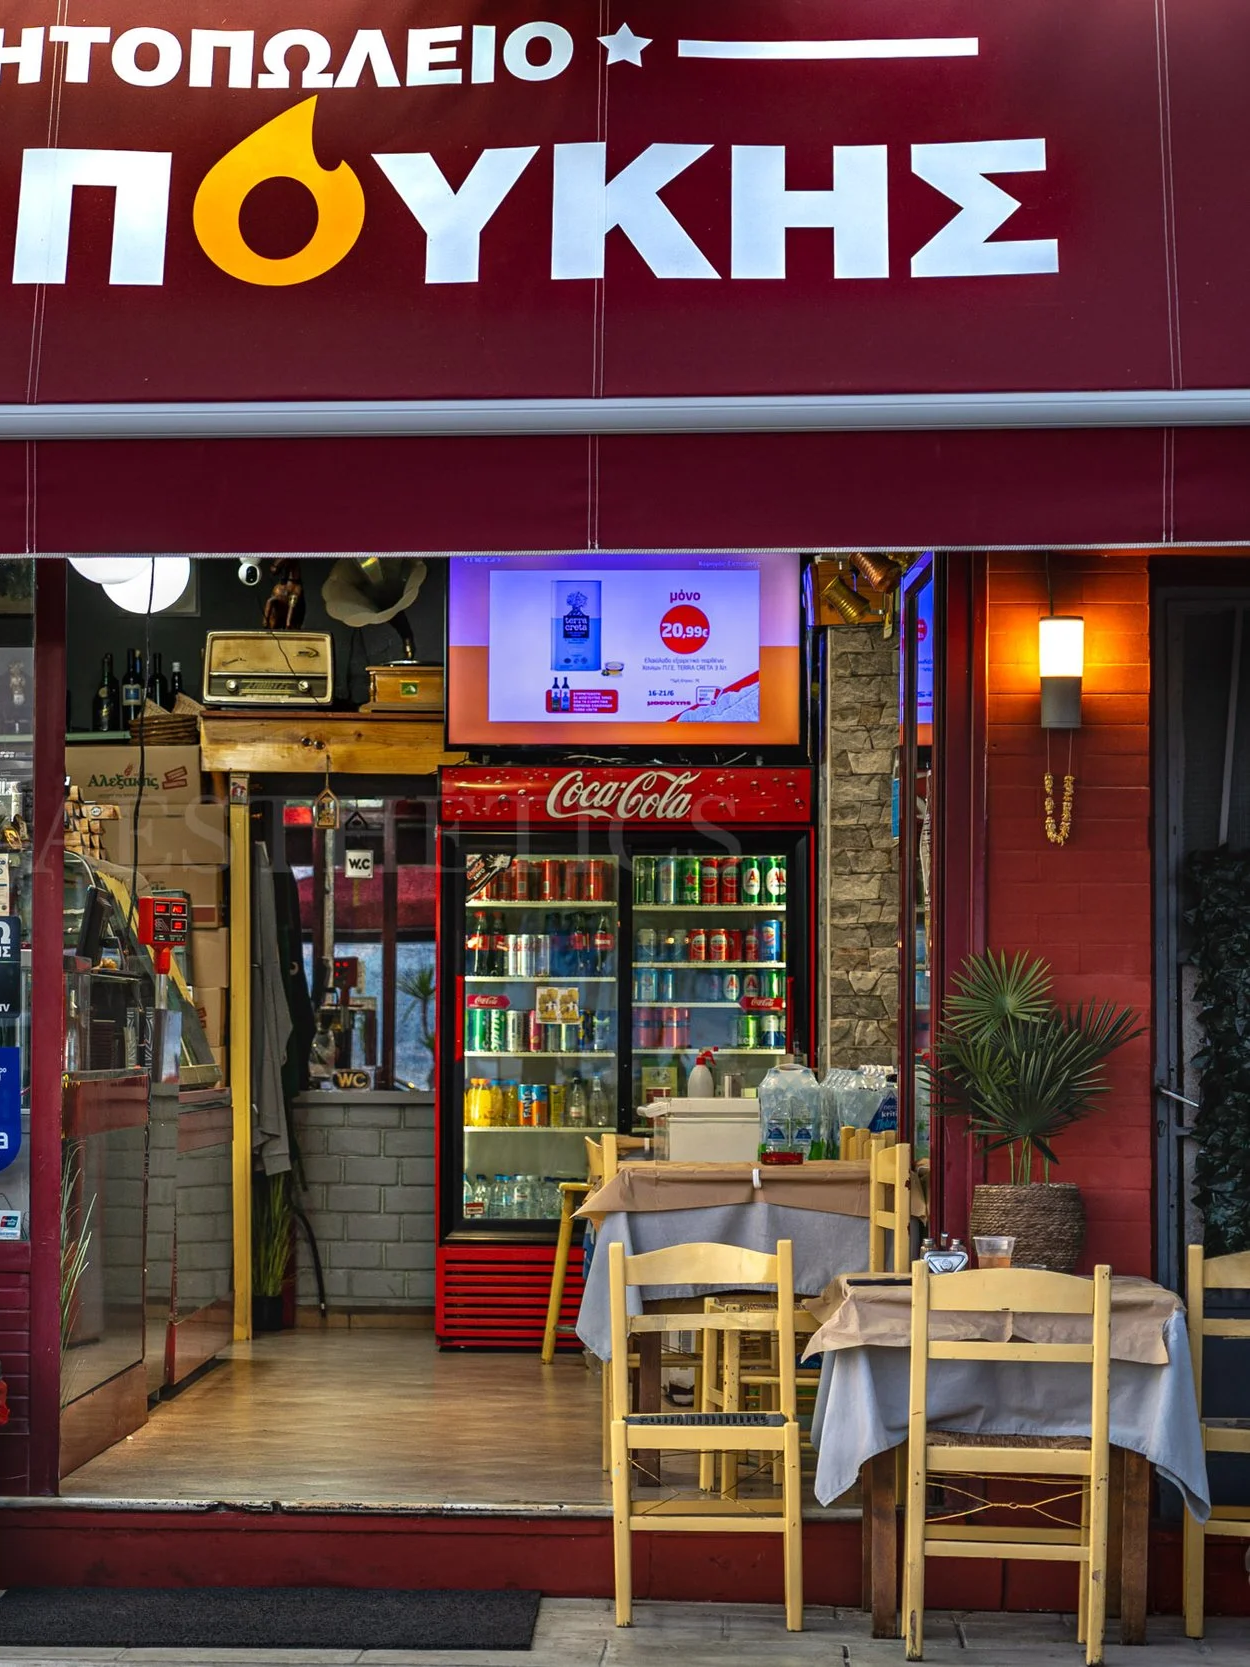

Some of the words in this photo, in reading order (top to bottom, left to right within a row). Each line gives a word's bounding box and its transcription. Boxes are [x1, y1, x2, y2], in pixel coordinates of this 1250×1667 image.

[670, 589, 701, 604] μόνο
[564, 624, 588, 632] creta
[661, 622, 709, 639] 20,99€
[648, 689, 675, 697] 16-21/6
[546, 769, 701, 819] Coca-Cola
[348, 858, 371, 870] W.C
[336, 1073, 366, 1087] WC
